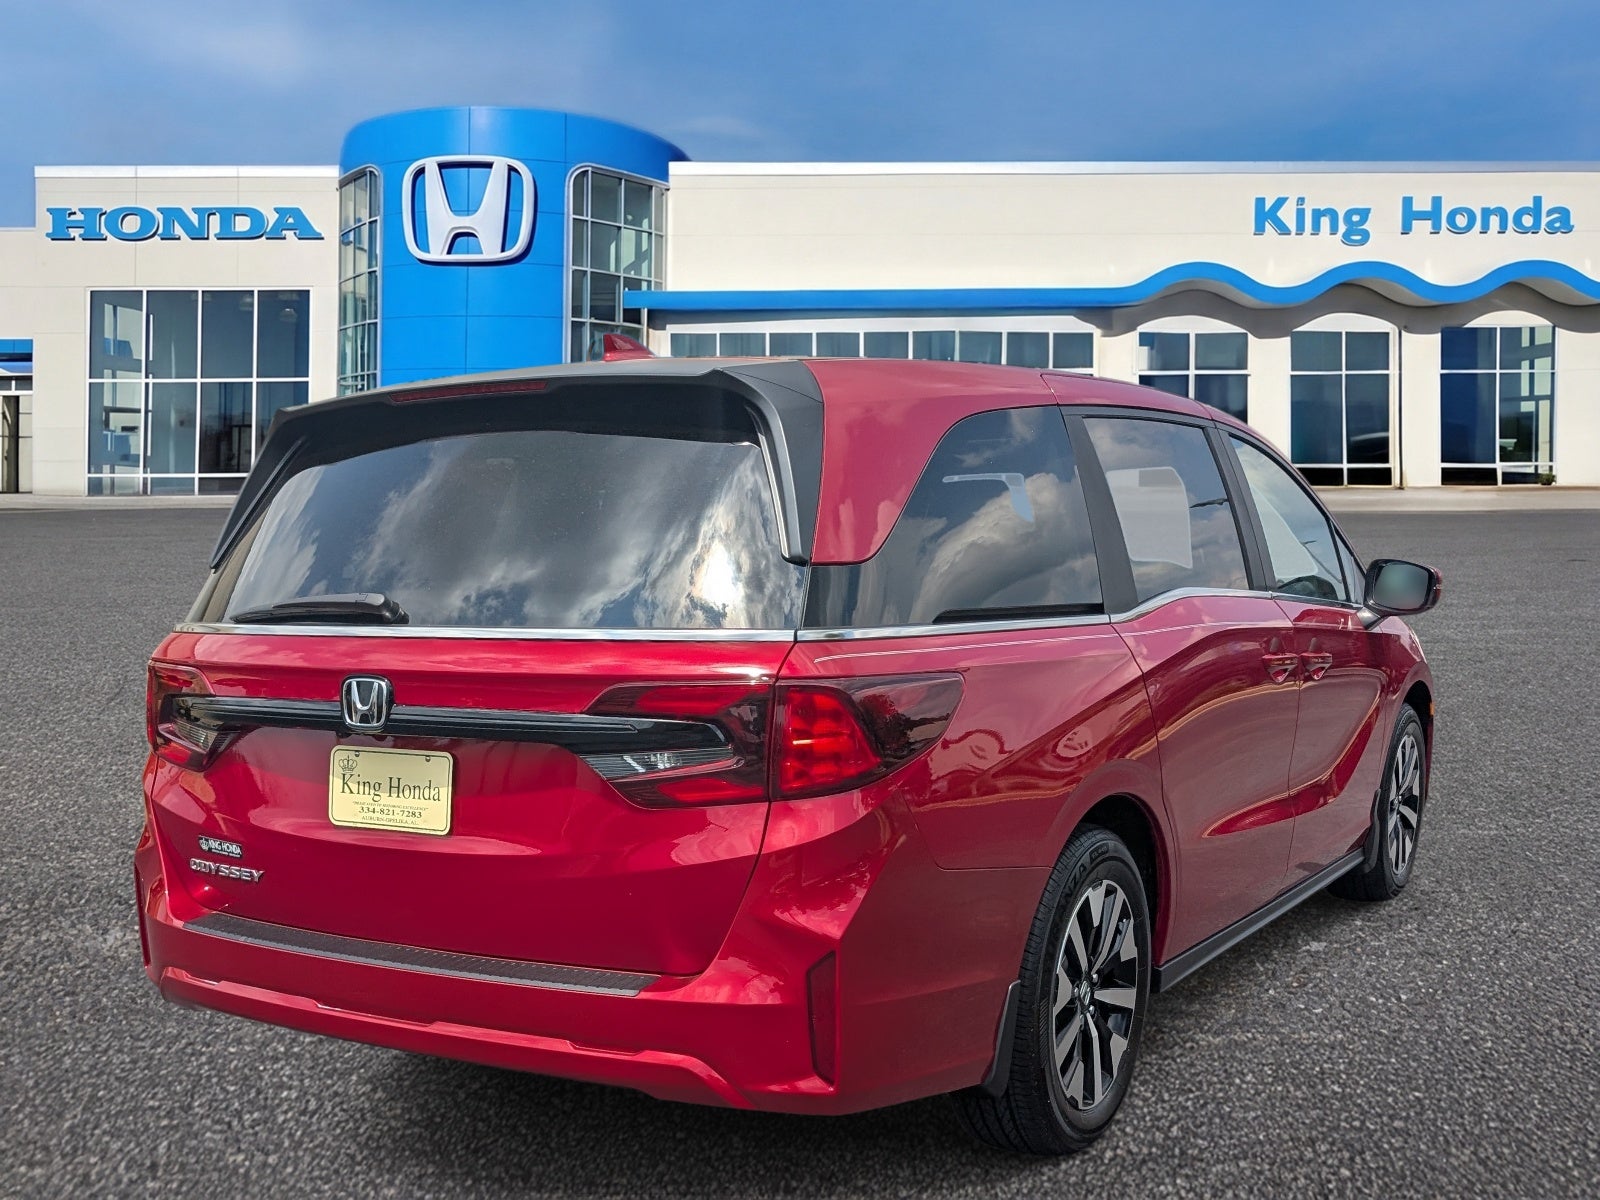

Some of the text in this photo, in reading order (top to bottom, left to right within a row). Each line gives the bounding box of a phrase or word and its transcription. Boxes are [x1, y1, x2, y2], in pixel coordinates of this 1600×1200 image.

[46, 206, 325, 241] HONDA
[1253, 195, 1575, 246] King Honda
[340, 773, 441, 803] King Honda
[358, 806, 422, 819] 334-821-7283
[208, 839, 222, 851] KING
[222, 842, 242, 855] HONDA
[189, 858, 265, 883] ODYSSEY
